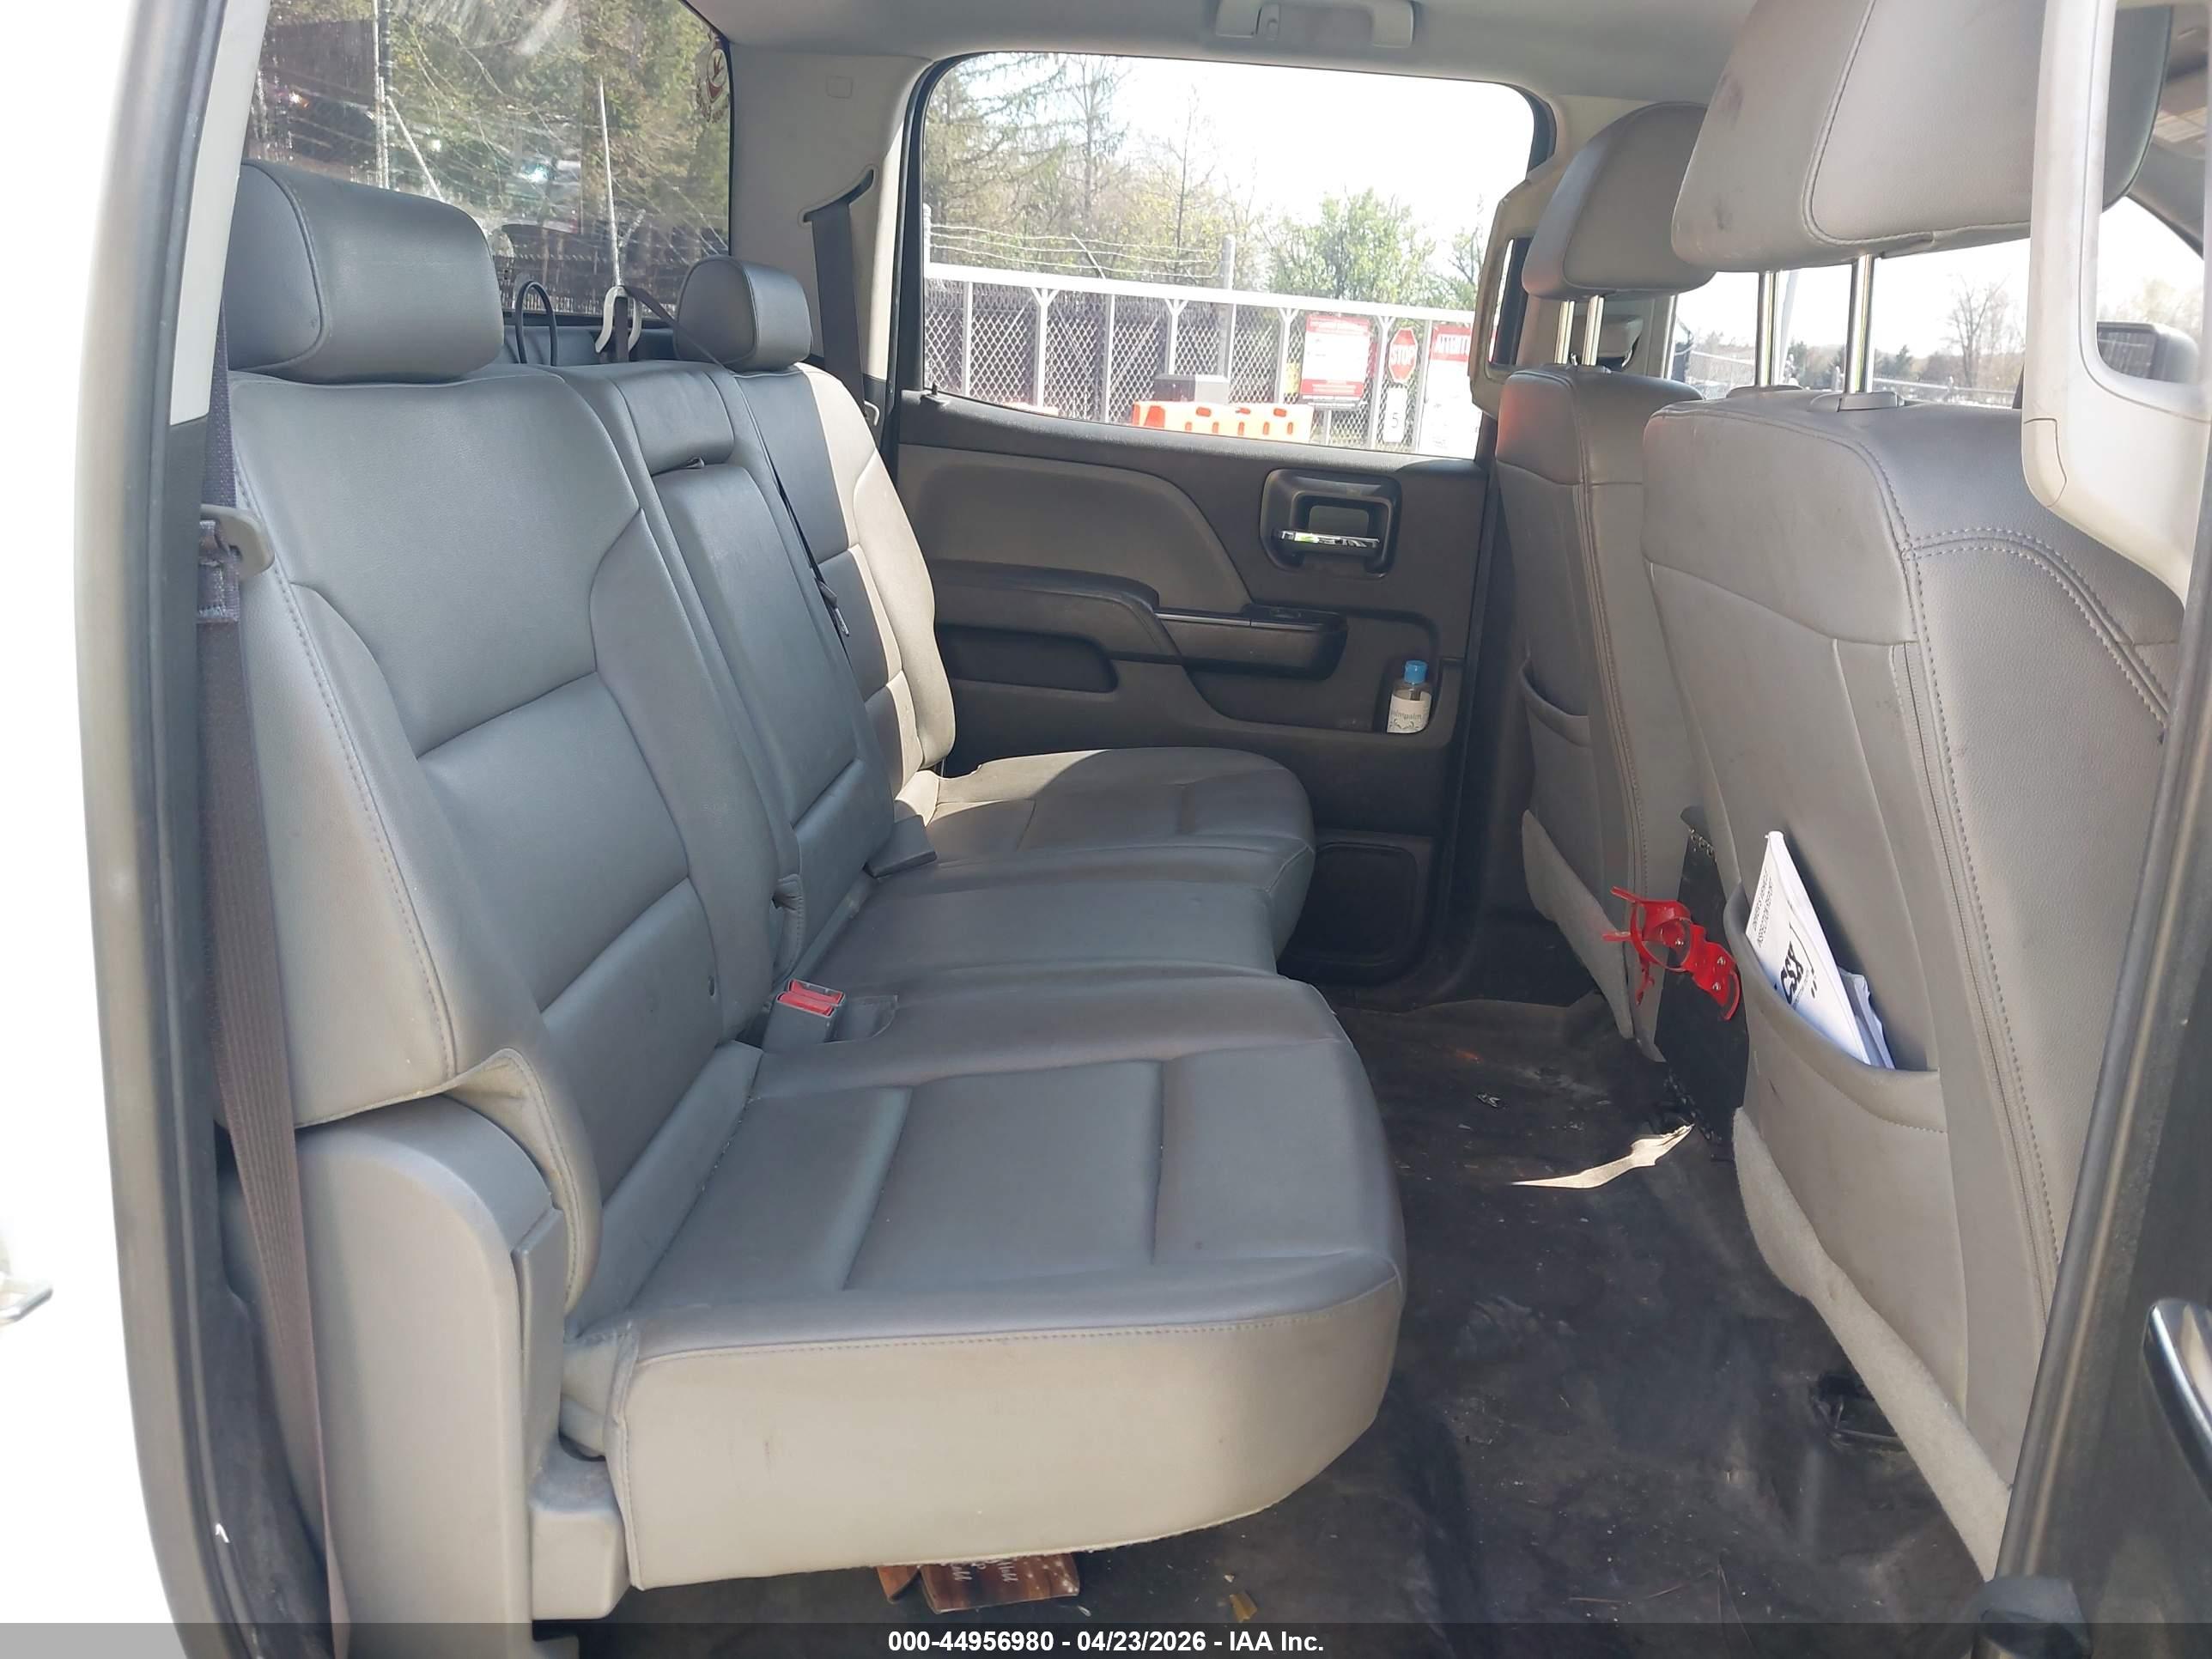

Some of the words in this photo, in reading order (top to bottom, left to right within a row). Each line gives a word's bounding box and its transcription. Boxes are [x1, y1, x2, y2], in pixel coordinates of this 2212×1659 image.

[1390, 344, 1415, 366] STOP
[1391, 411, 1400, 428] 5
[1781, 941, 1804, 1005] CSX
